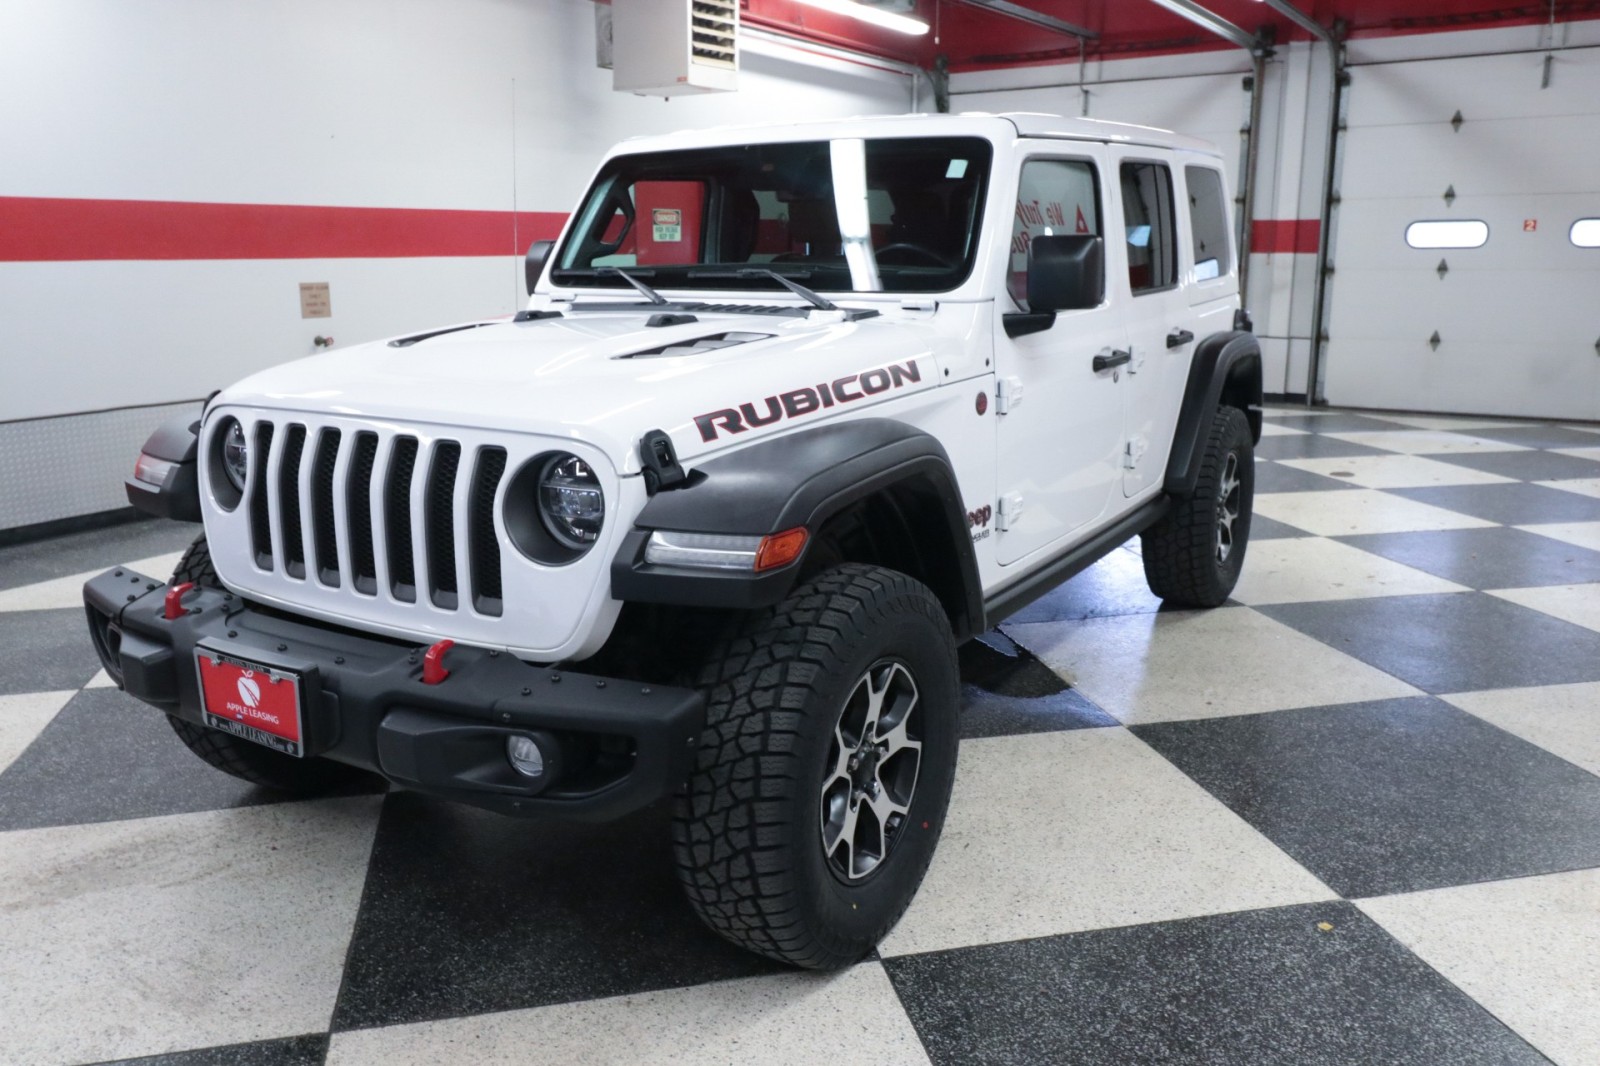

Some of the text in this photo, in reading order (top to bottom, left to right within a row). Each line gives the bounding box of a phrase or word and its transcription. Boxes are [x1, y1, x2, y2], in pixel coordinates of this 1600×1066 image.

[1525, 220, 1535, 231] 2
[693, 360, 921, 442] RUBICON
[968, 504, 991, 528] eep
[227, 702, 280, 725] APPLE LEASING
